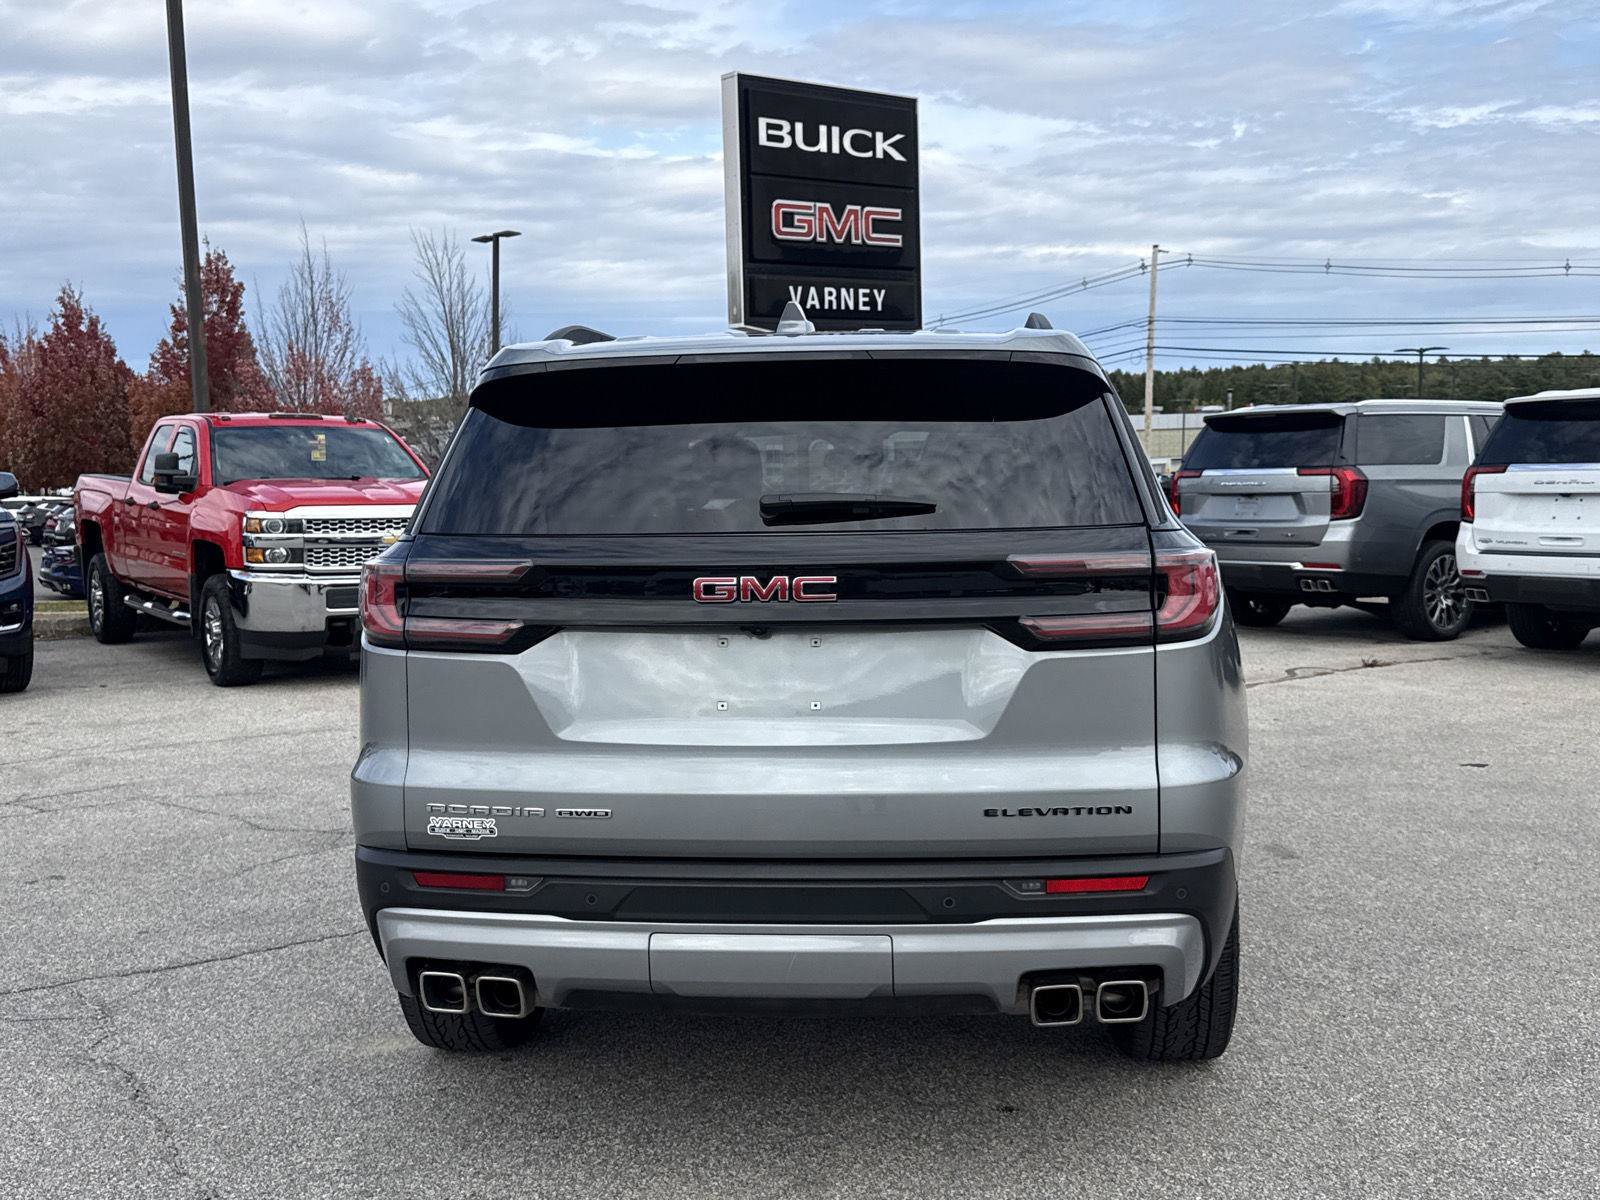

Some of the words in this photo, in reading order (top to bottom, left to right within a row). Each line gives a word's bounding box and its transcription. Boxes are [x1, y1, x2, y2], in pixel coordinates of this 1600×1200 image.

[757, 116, 908, 163] BUICK
[771, 198, 903, 248] GMC
[788, 285, 886, 311] VARNEY
[693, 575, 838, 603] GMC
[431, 819, 493, 829] VARNEY
[556, 809, 612, 818] AWD
[983, 805, 1133, 818] ELEVATION
